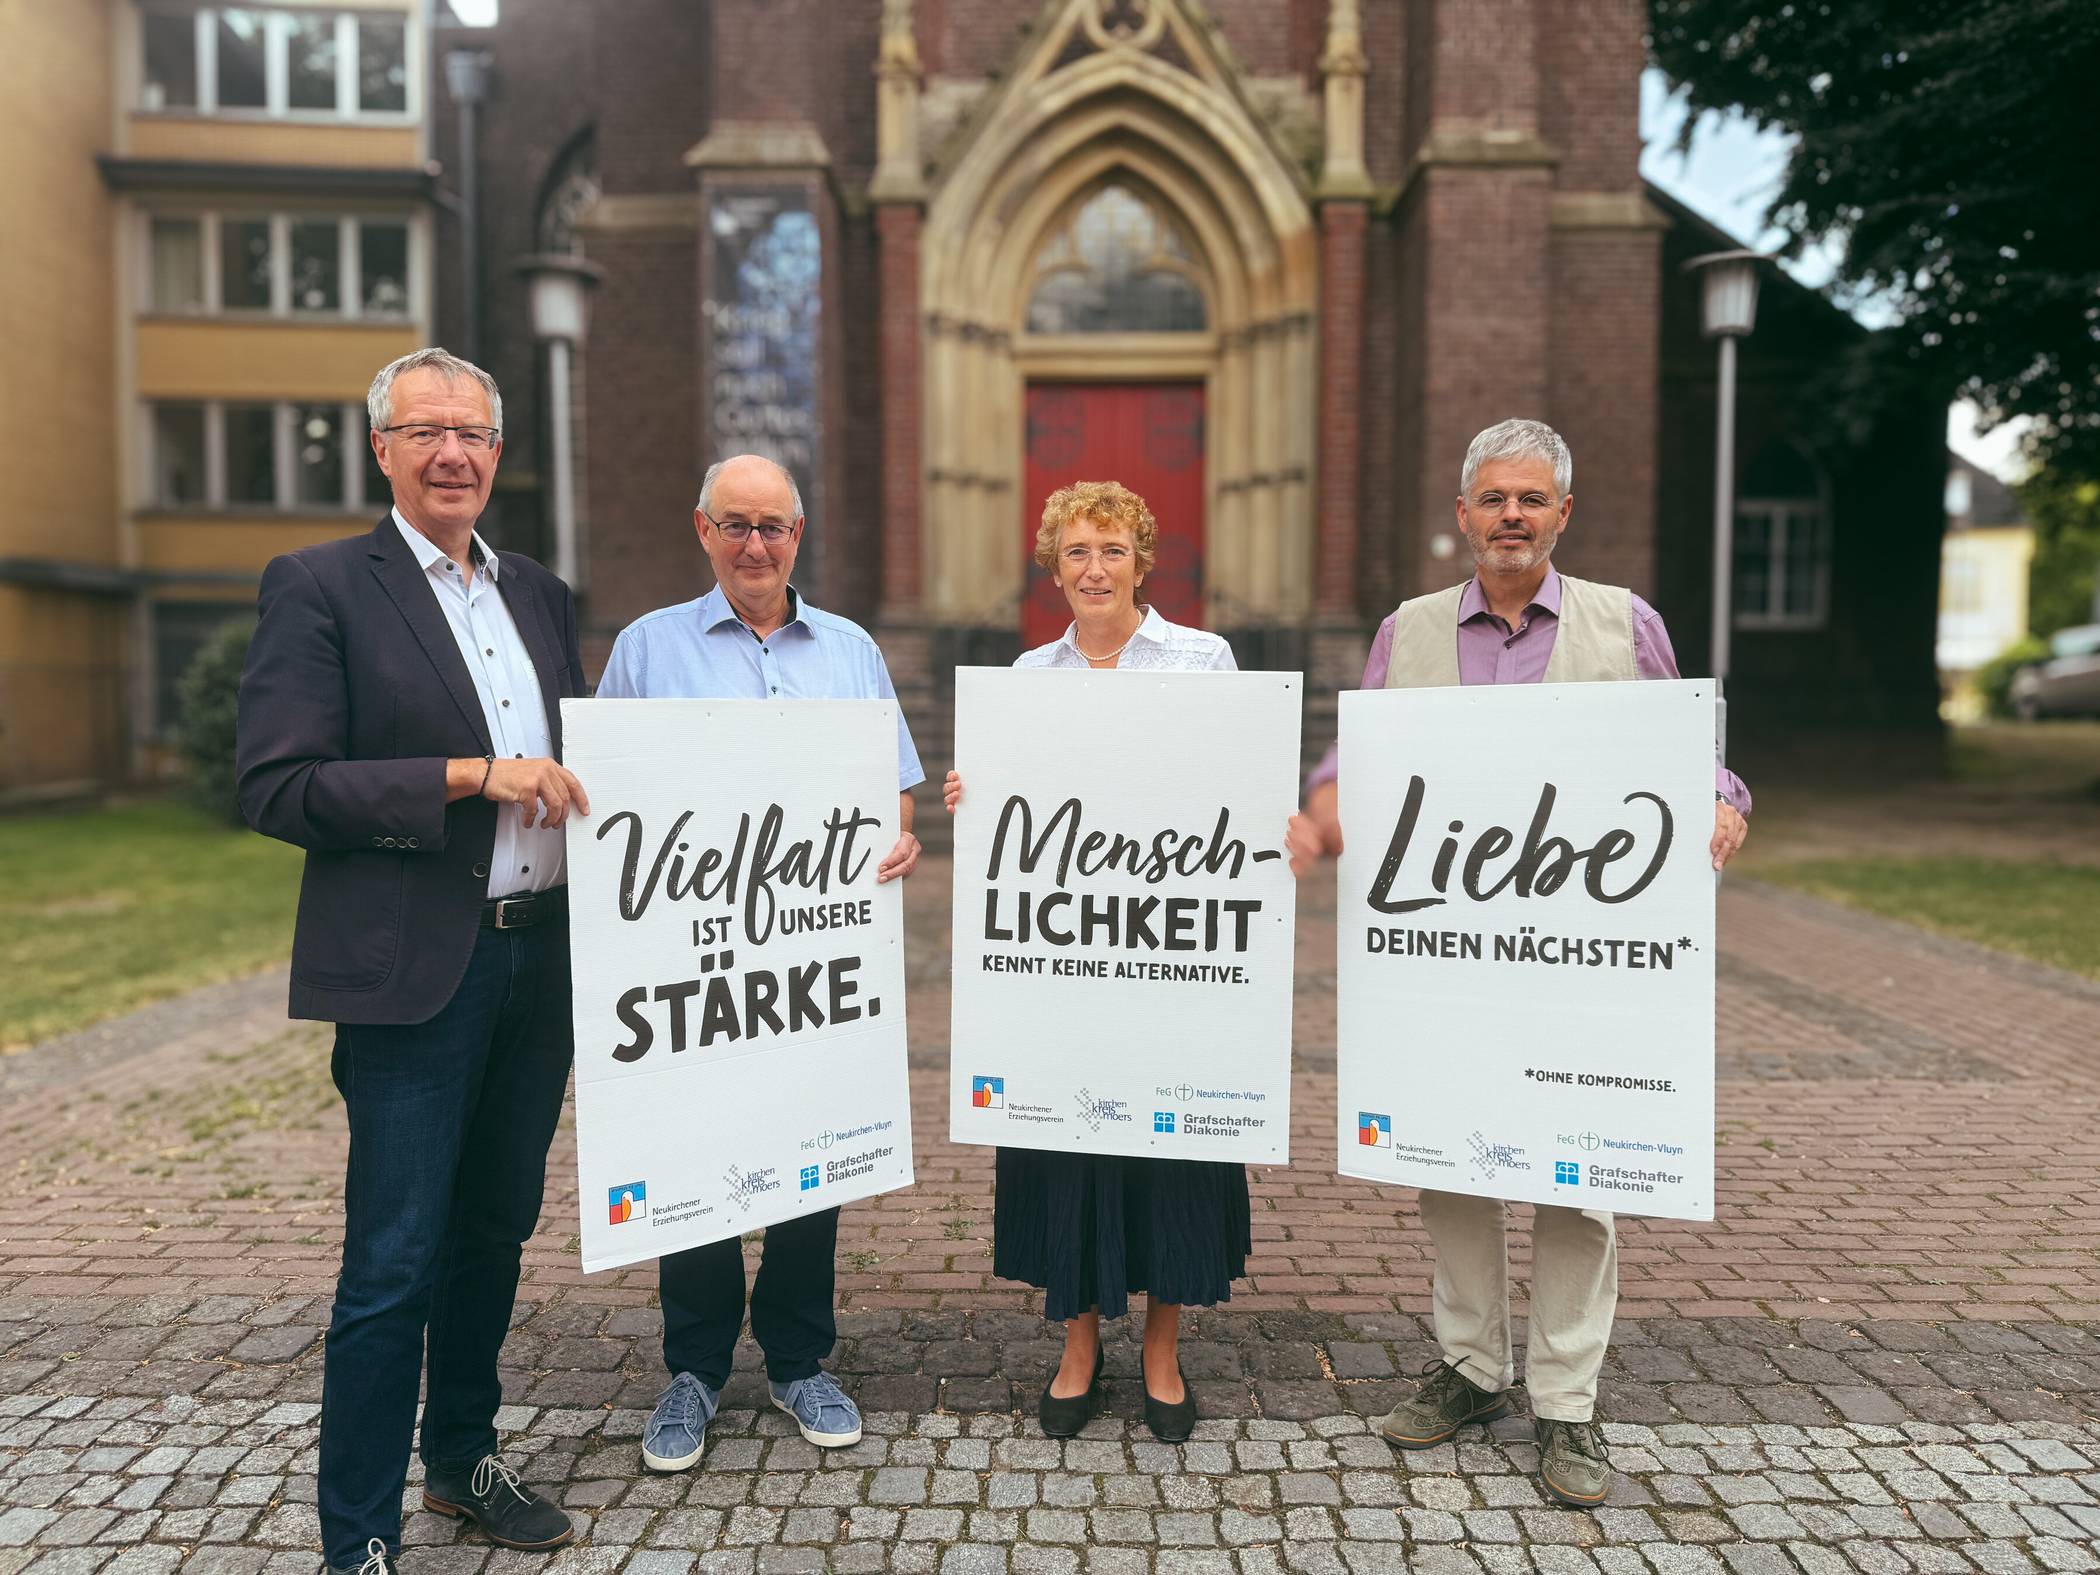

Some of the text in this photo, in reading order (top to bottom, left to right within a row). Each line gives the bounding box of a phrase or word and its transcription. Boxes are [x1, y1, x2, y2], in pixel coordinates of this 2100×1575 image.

[986, 794, 1282, 888] Mensch-
[1367, 774, 1674, 914] Liebe
[595, 802, 881, 947] Vielfalt
[692, 900, 872, 947] IST UNSERE
[983, 888, 1263, 952] LICHKEIT
[1366, 925, 1482, 960] DEINEN
[982, 954, 1250, 984] KENNT KEINE ALTERNATIVE.
[611, 950, 881, 1064] STÄRKE.
[1577, 1072, 1677, 1093] KOMPROMISSE.
[1098, 1098, 1127, 1108] kirchen
[1155, 1087, 1266, 1102] FeG Neukirchen-Vluyn
[1008, 1103, 1053, 1113] Neukirchener
[1008, 1112, 1064, 1124] Erziehungsverein
[1103, 1113, 1132, 1122] moers
[1183, 1114, 1266, 1127] Grafschafter
[800, 1120, 892, 1150] FeG Neukirchen-Vluyn
[1183, 1125, 1240, 1137] Diakonie
[1396, 1143, 1443, 1157] Neukirchener
[1493, 1143, 1525, 1154] kirchen
[1556, 1134, 1684, 1155] FeG Neukirchen-Vluyn
[826, 1146, 894, 1172] Grafschafter
[1396, 1152, 1456, 1168] Erziehungsverein
[1498, 1159, 1531, 1170] moers
[747, 1167, 776, 1181] kirchen
[826, 1163, 874, 1184] Diakonie
[1589, 1165, 1684, 1184] Grafschafter
[752, 1180, 781, 1194] moers
[1589, 1177, 1655, 1194] Diakonie
[652, 1198, 701, 1215] Neukirchener
[652, 1206, 714, 1227] Erziehungsverein
